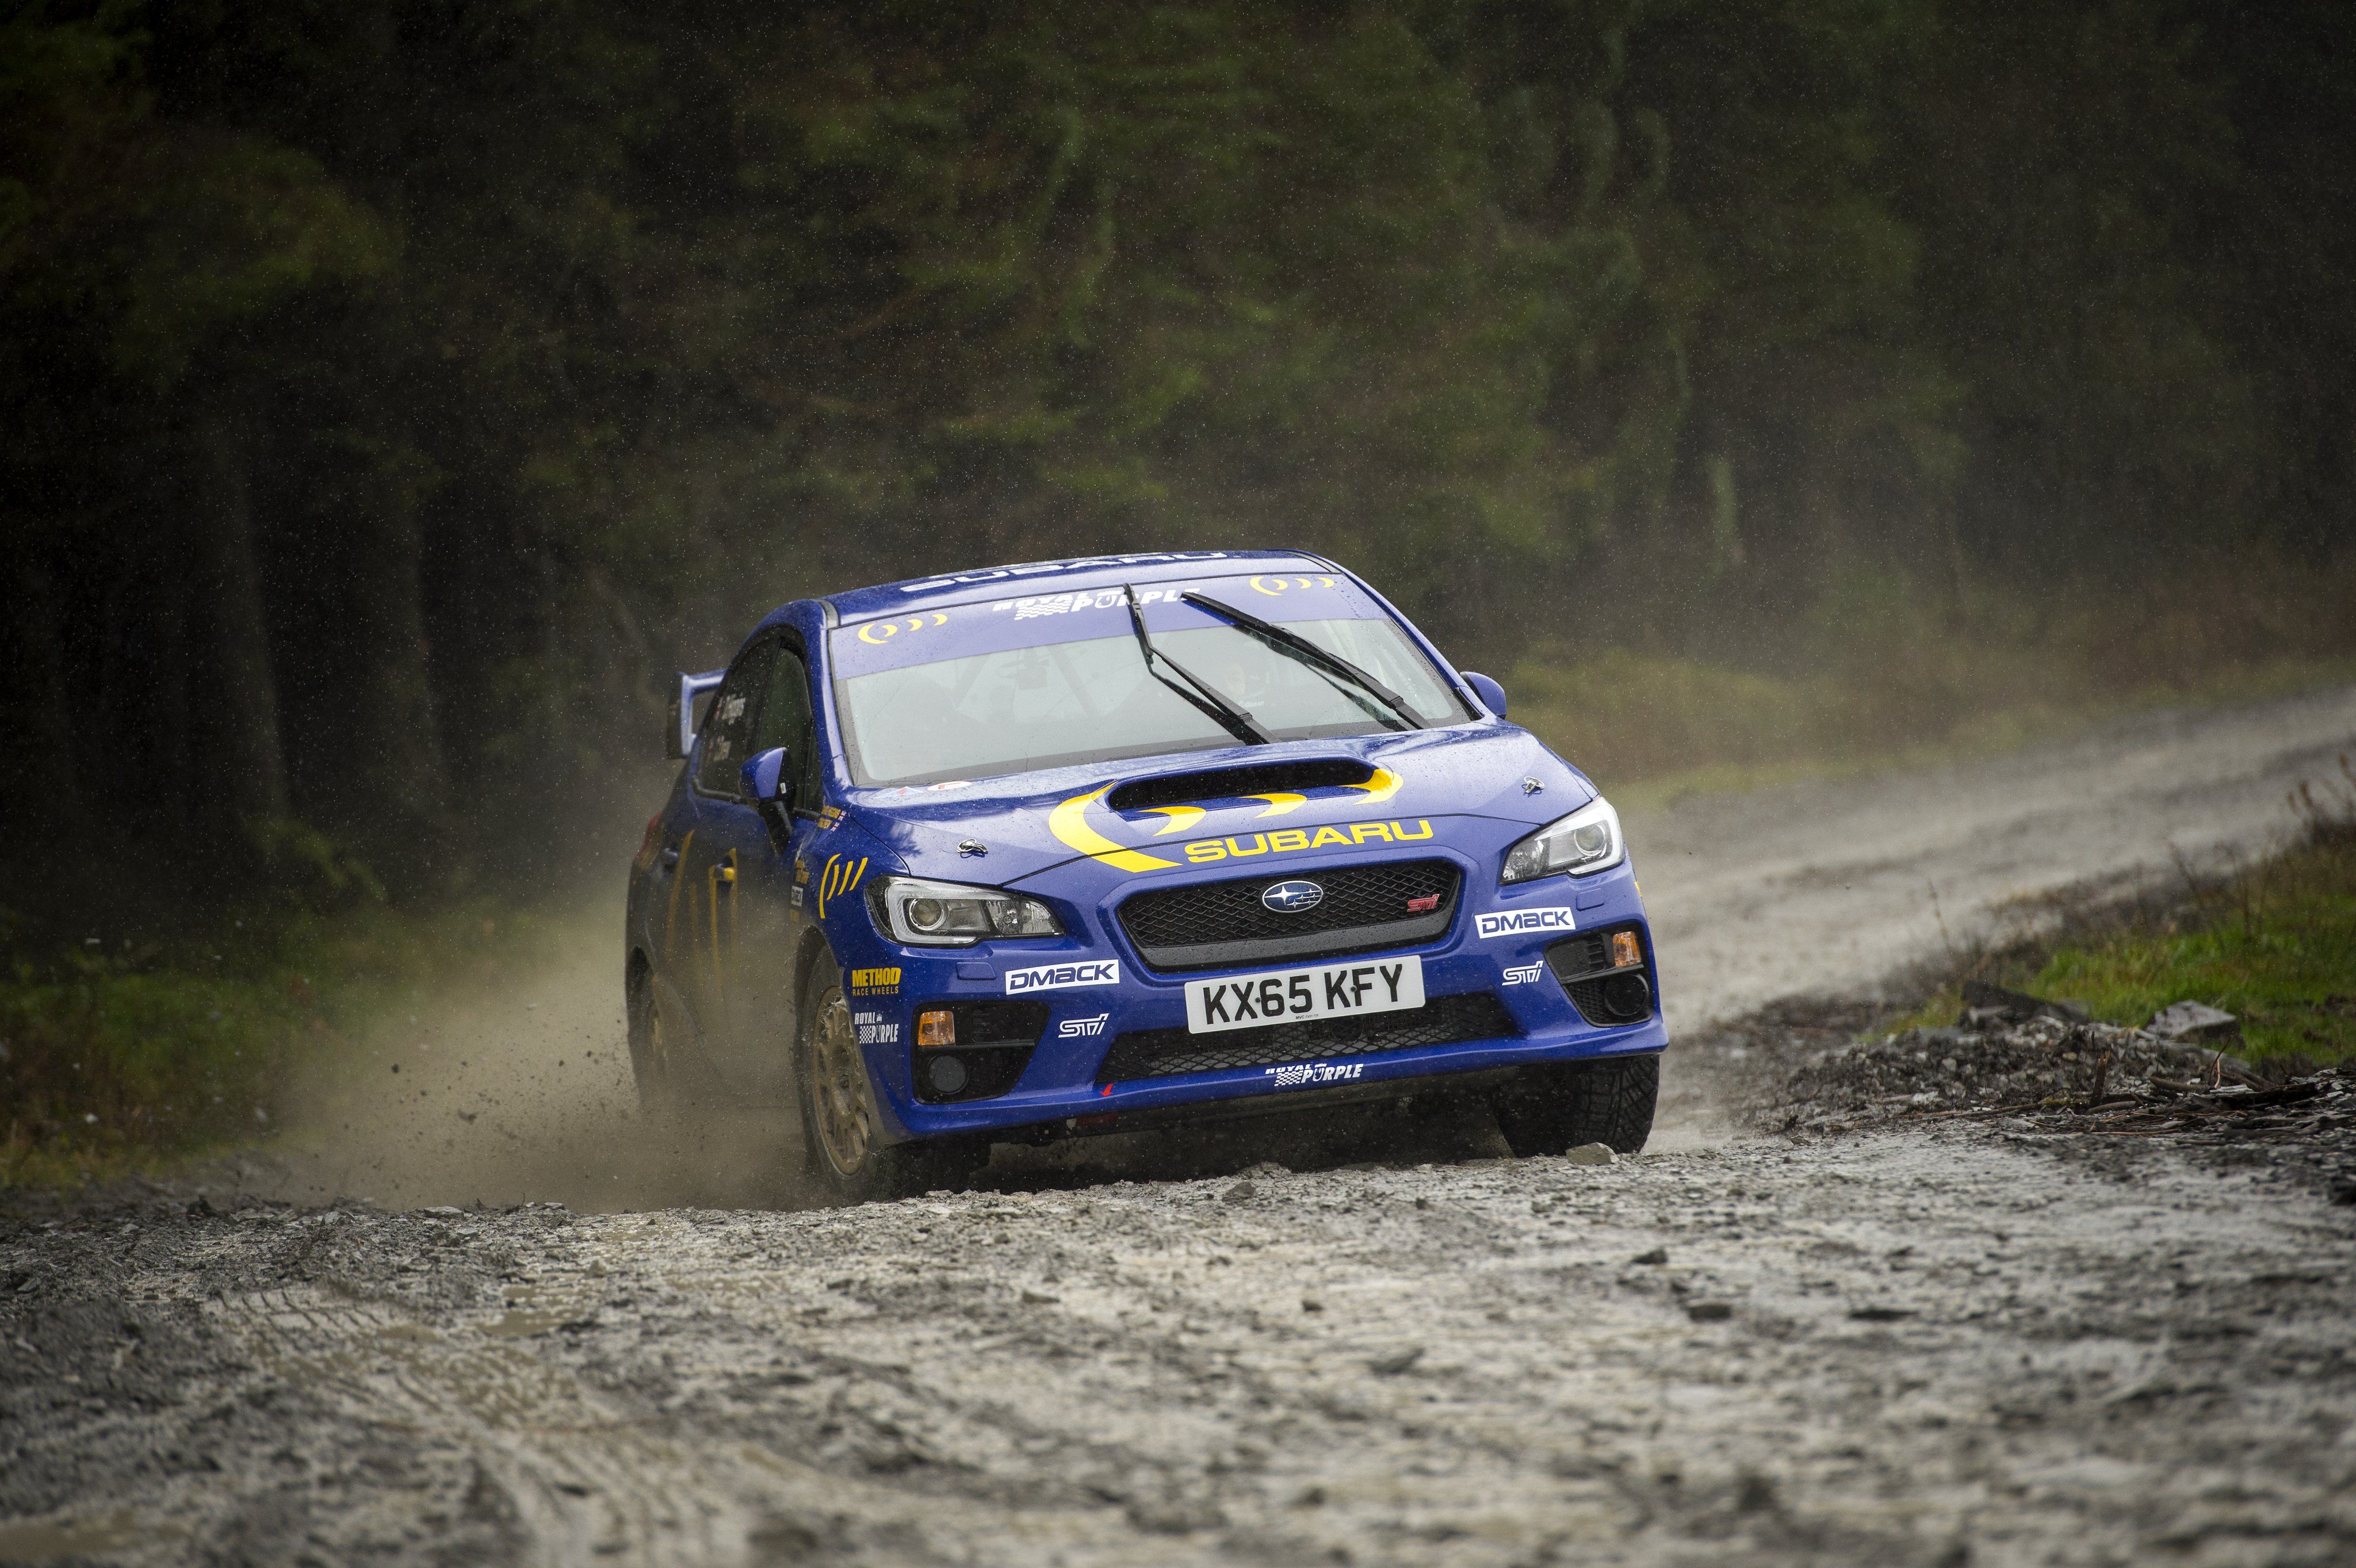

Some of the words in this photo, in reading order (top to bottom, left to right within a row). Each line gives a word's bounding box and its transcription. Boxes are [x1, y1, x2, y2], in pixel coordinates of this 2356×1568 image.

[1185, 820, 1433, 863] SUBARU
[852, 967, 901, 987] METHOD
[852, 988, 869, 996] RACE
[871, 986, 899, 995] WHEELS
[1203, 974, 1313, 1024] KX65
[1326, 963, 1403, 1010] KFY
[855, 1012, 875, 1024] ROYAL
[871, 1024, 899, 1043] PURPLE
[1265, 1064, 1312, 1074] ROYAL
[1301, 1064, 1364, 1083] PURPLE
